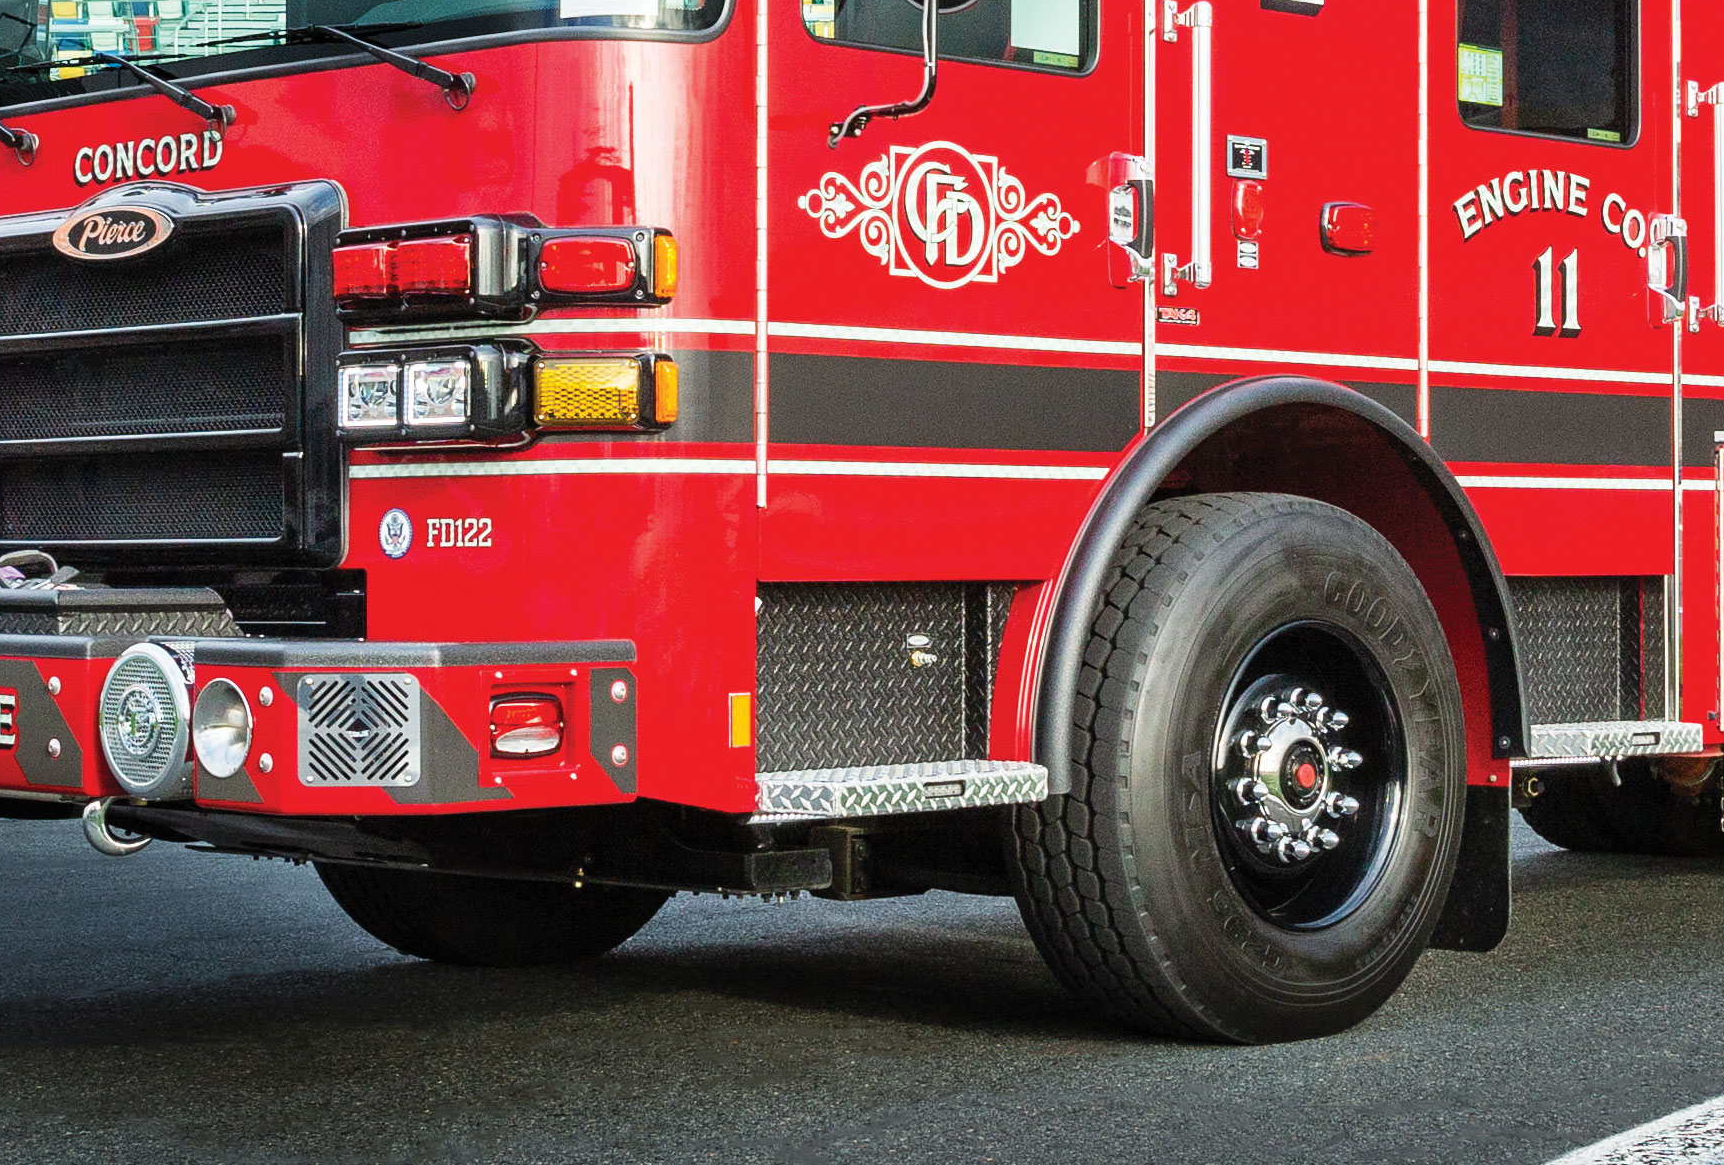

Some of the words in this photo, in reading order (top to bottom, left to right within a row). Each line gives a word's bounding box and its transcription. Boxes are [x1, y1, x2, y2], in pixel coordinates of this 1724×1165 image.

[74, 130, 224, 186] CONCORD
[78, 215, 146, 252] Pierce
[1453, 169, 1590, 242] ENGINE
[1602, 193, 1647, 258] CO.
[1532, 244, 1582, 339] 11
[426, 517, 492, 548] FD122
